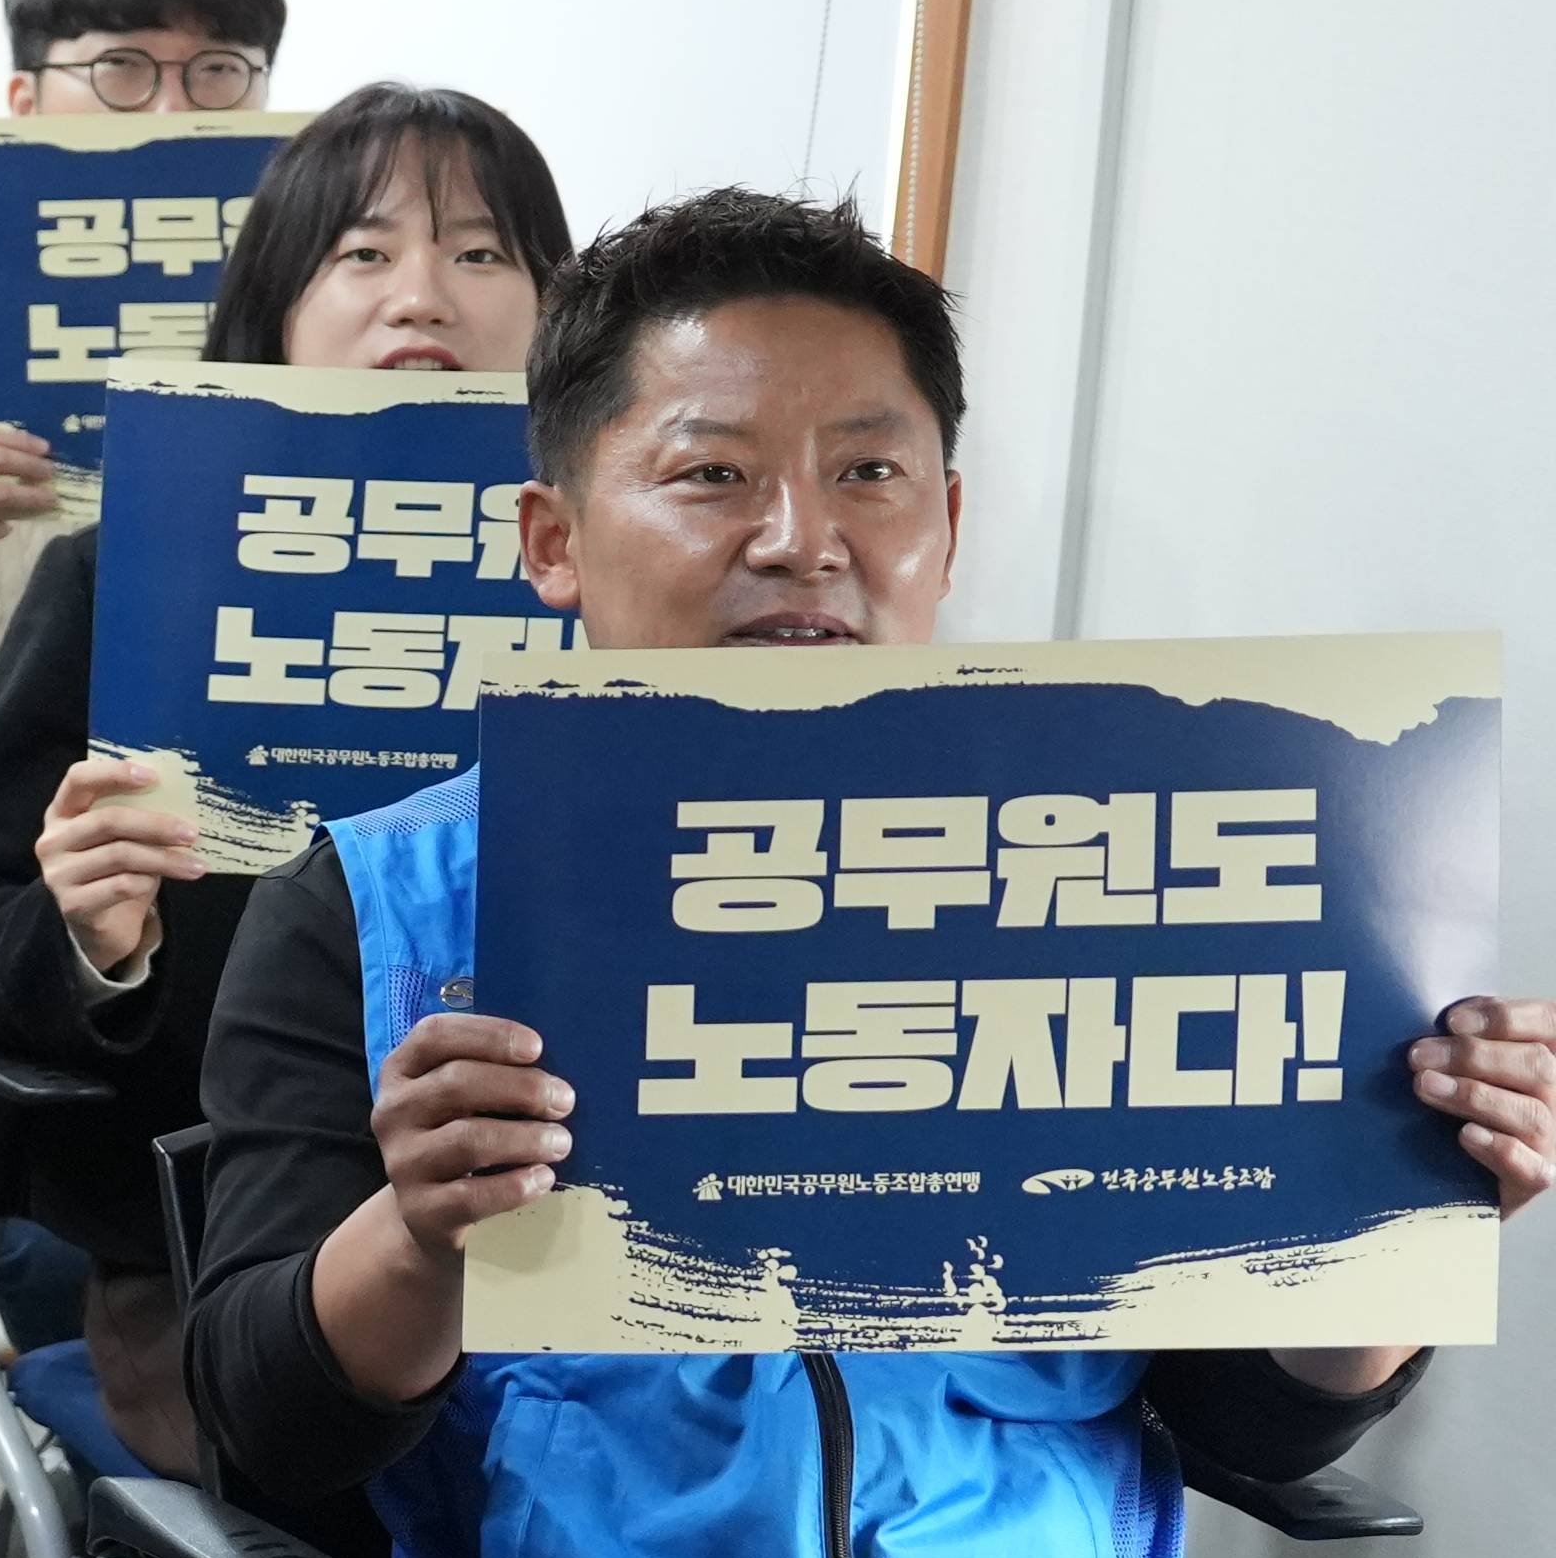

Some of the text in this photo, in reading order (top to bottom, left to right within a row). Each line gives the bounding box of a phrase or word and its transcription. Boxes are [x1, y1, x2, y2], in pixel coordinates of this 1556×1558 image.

[671, 788, 1322, 932] 공무원도
[638, 971, 1346, 1115] 노동자다!
[728, 1166, 1276, 1195] 대한민국공무원노동조합총연맹 전국공무원노동조합
